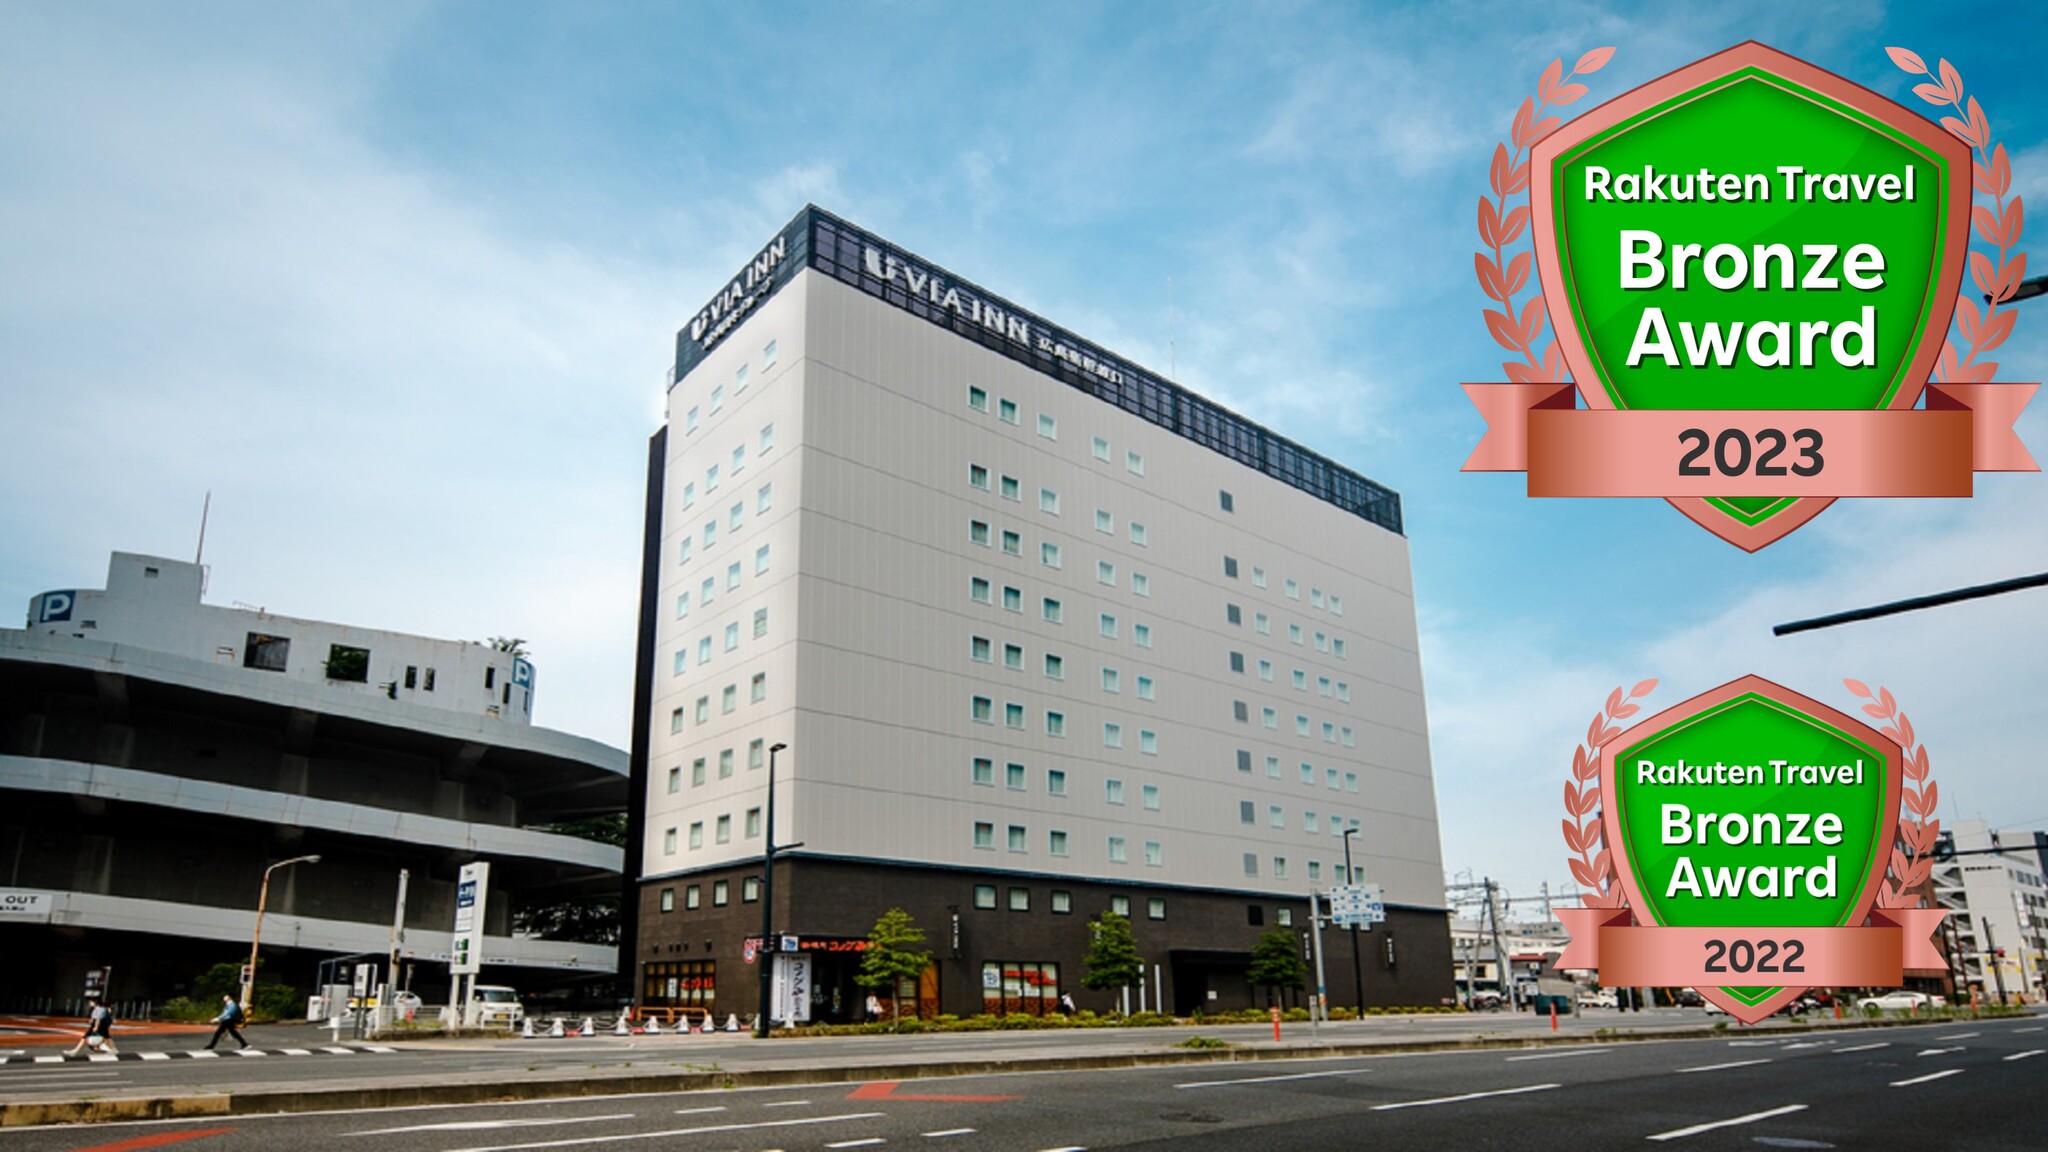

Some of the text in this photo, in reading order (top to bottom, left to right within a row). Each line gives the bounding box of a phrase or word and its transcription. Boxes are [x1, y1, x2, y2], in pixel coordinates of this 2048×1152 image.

[711, 281, 743, 321] VIA
[746, 236, 786, 289] INN
[903, 265, 1031, 347] VIA INN
